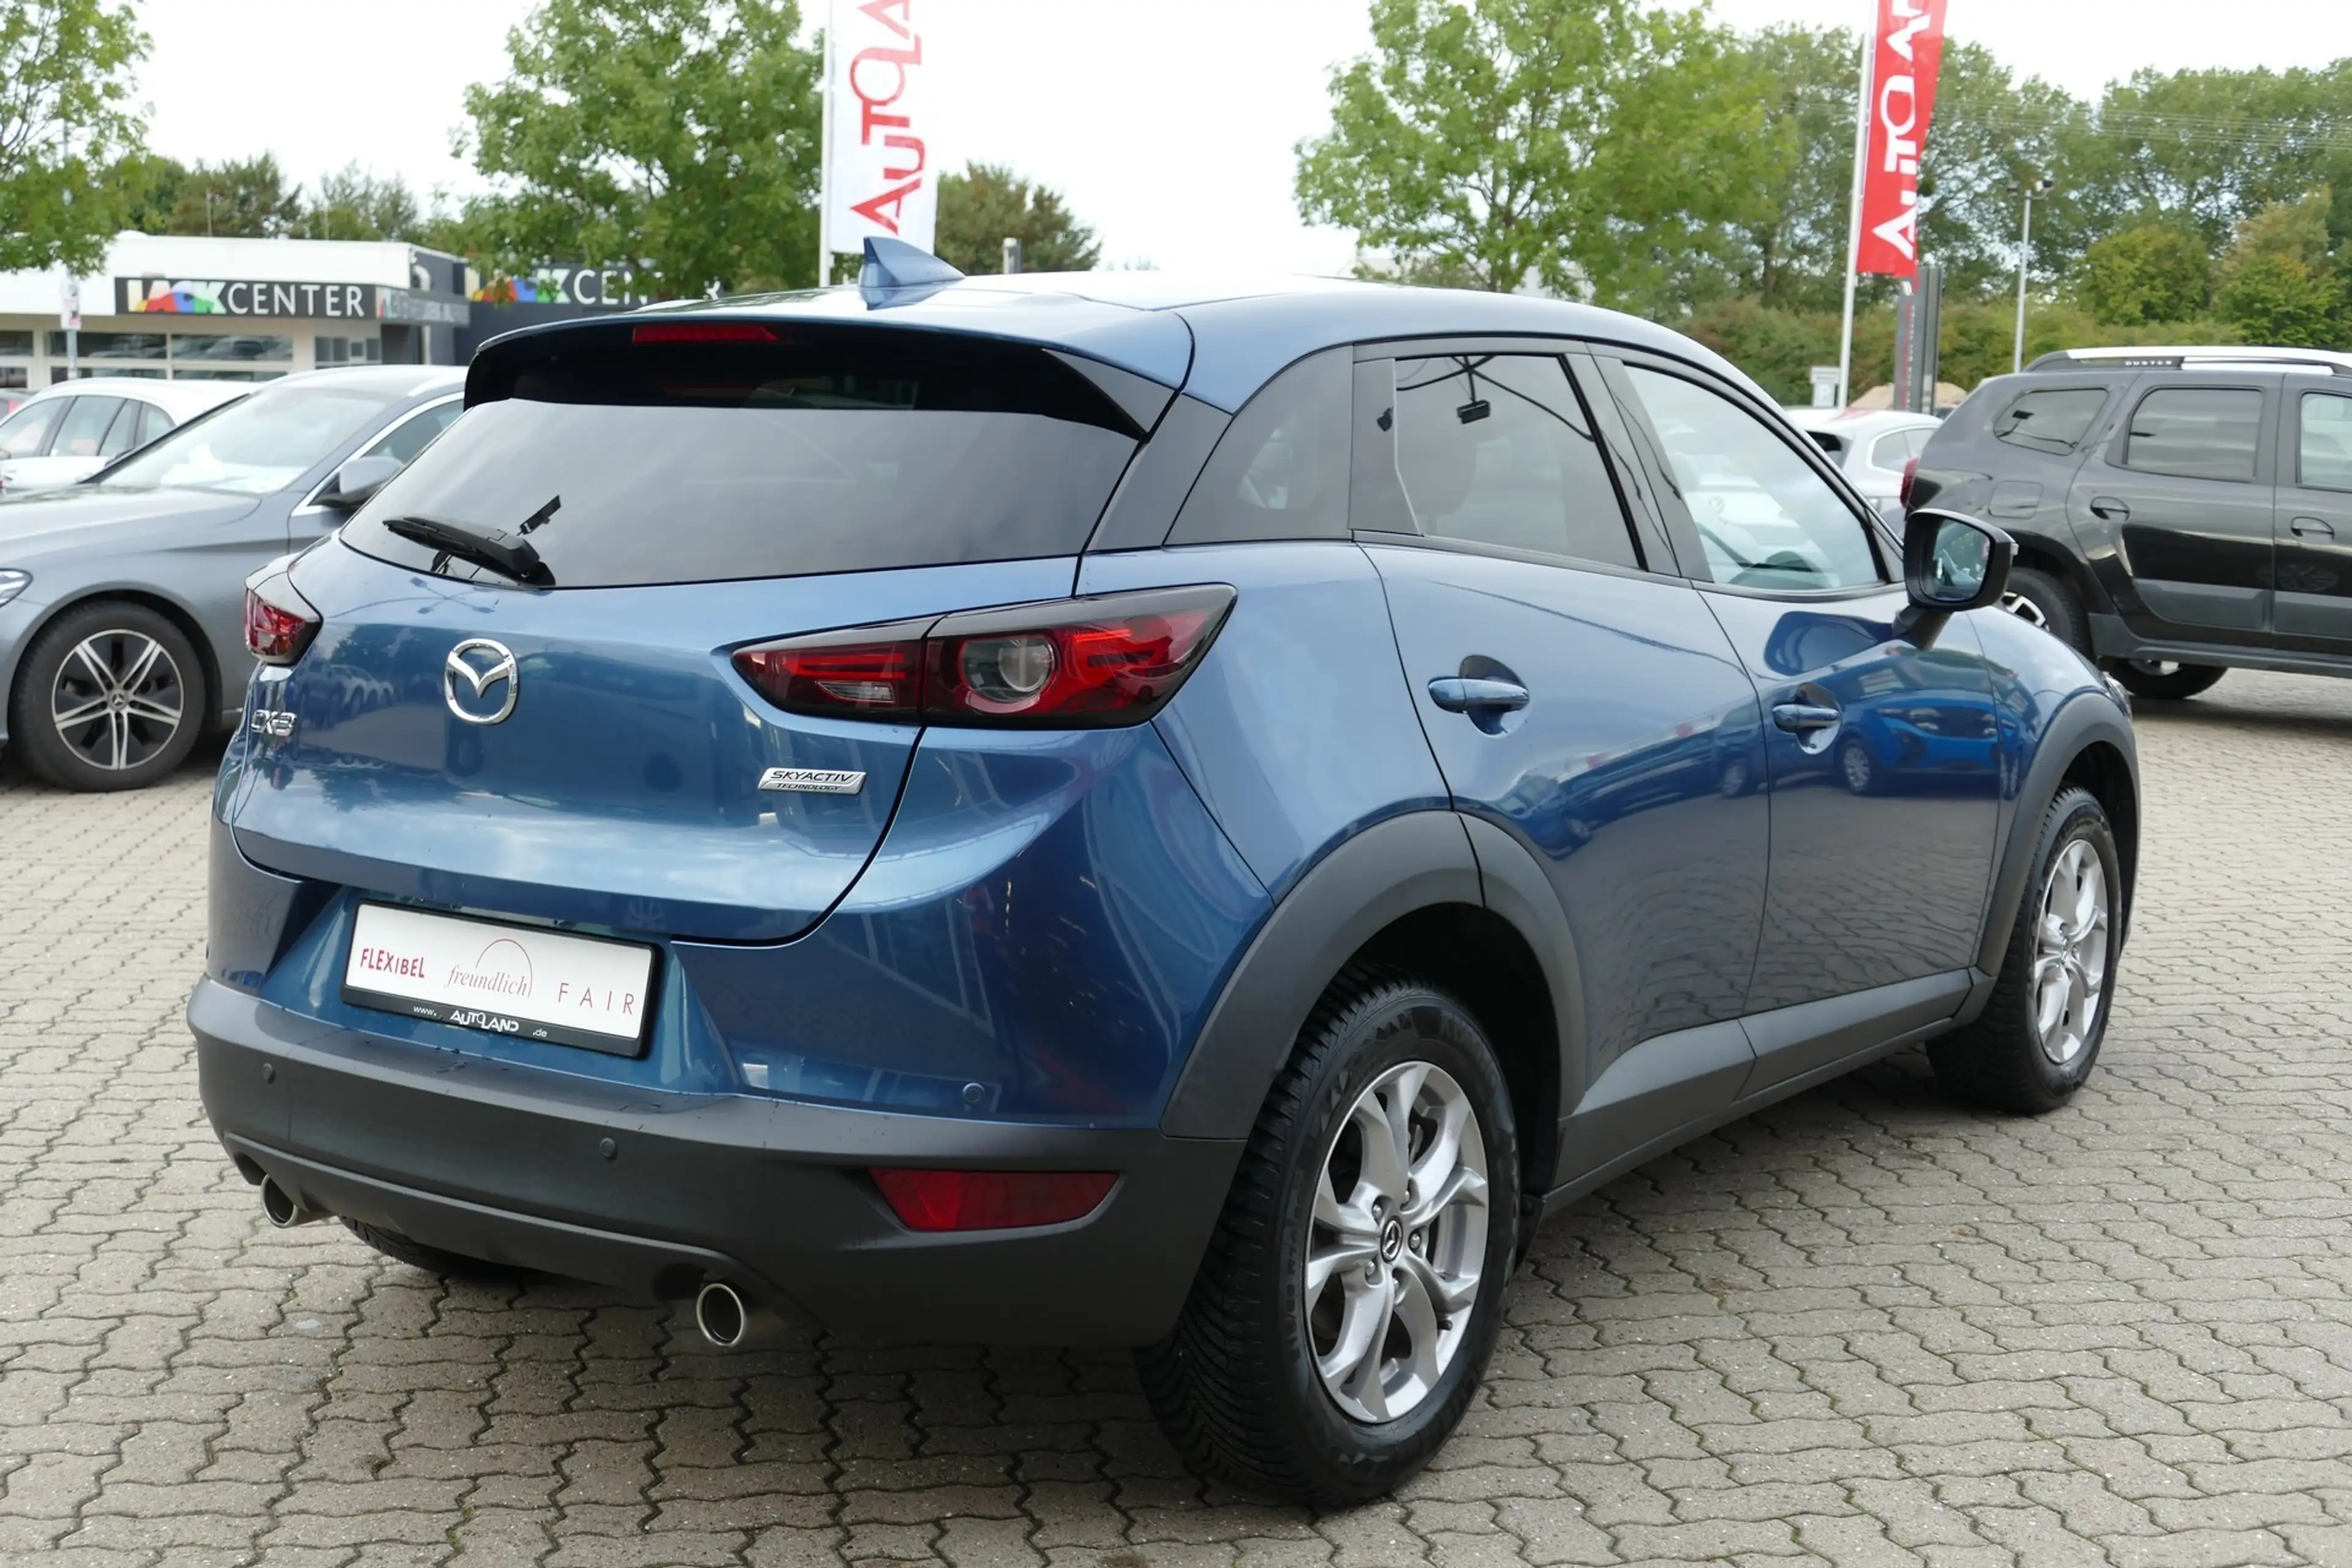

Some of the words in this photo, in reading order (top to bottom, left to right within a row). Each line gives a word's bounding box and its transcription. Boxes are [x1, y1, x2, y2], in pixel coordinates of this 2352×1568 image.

[771, 770, 854, 782] SKYACTIV
[777, 783, 841, 791] TECHNOLOGY
[360, 948, 424, 979] FLEXIBEL
[444, 964, 527, 997] freundlich
[450, 1009, 519, 1033] AUTOLAND
